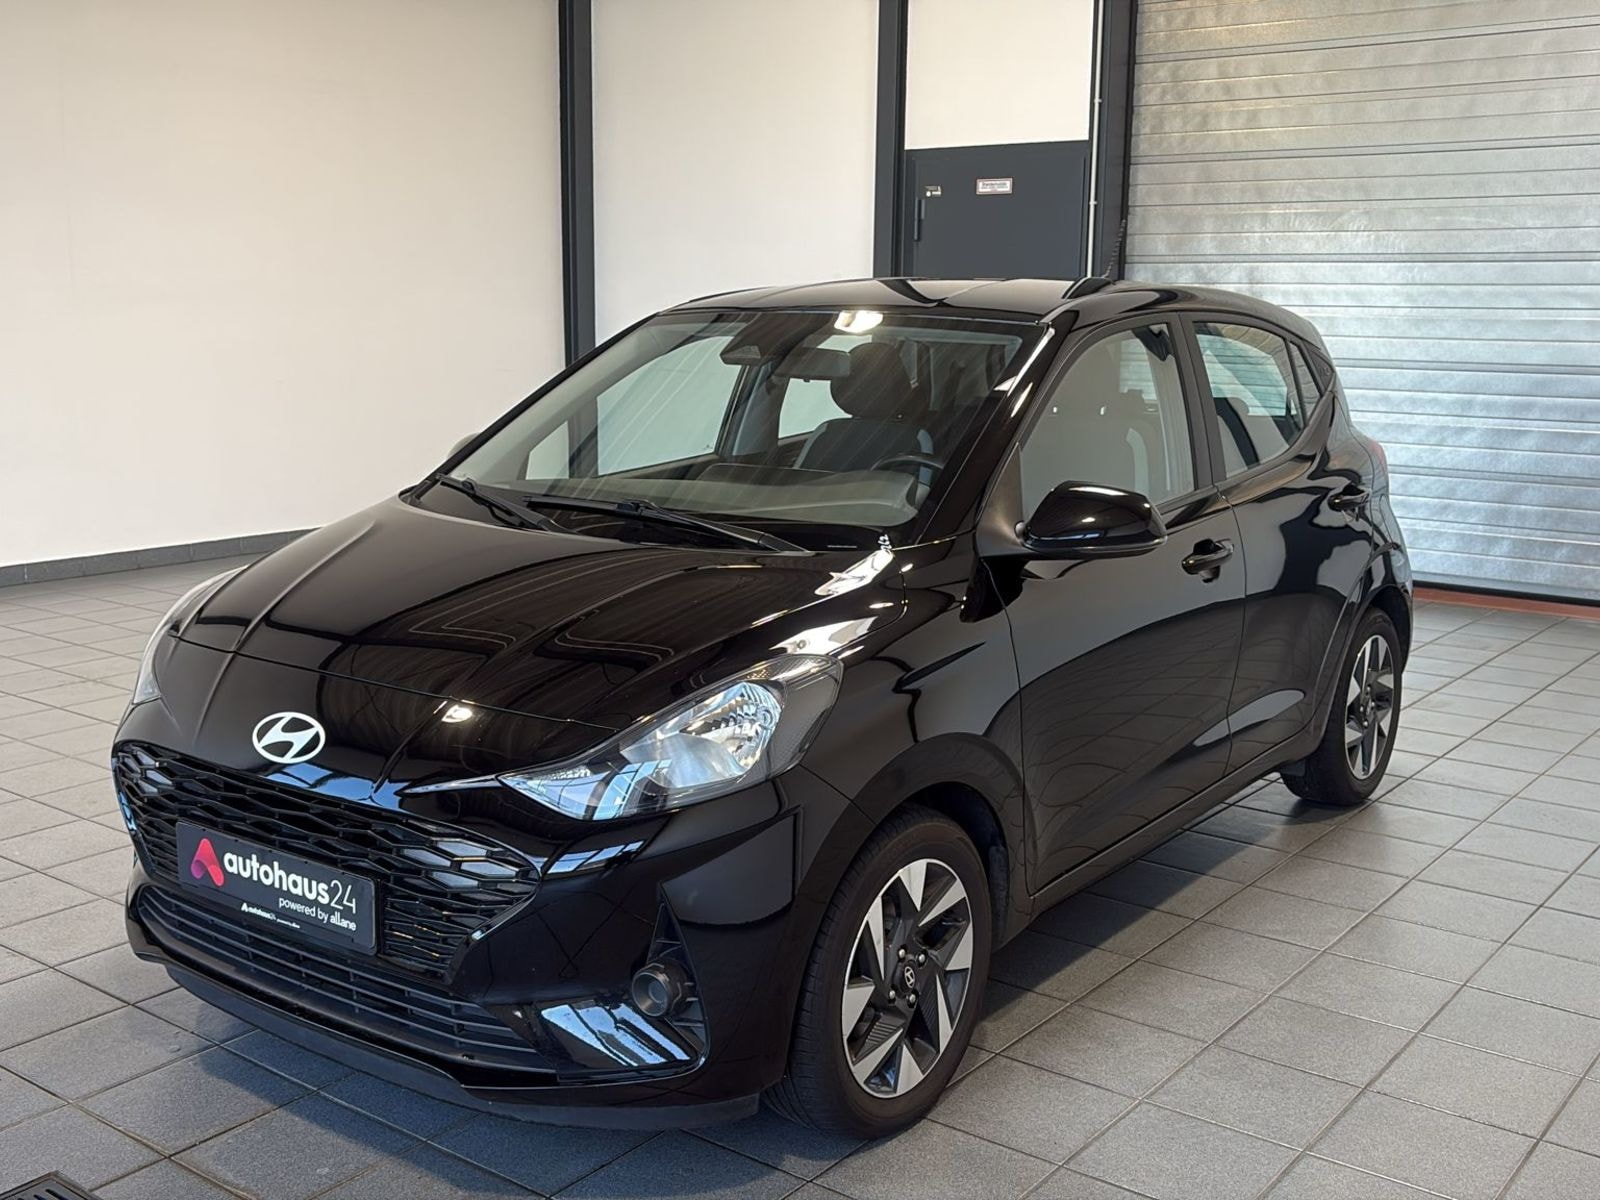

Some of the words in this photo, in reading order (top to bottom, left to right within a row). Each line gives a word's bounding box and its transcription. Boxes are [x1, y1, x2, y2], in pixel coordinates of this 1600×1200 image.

[223, 852, 357, 914] autohaus24
[279, 898, 316, 917] powered
[317, 907, 328, 924] by
[330, 911, 357, 931] allane
